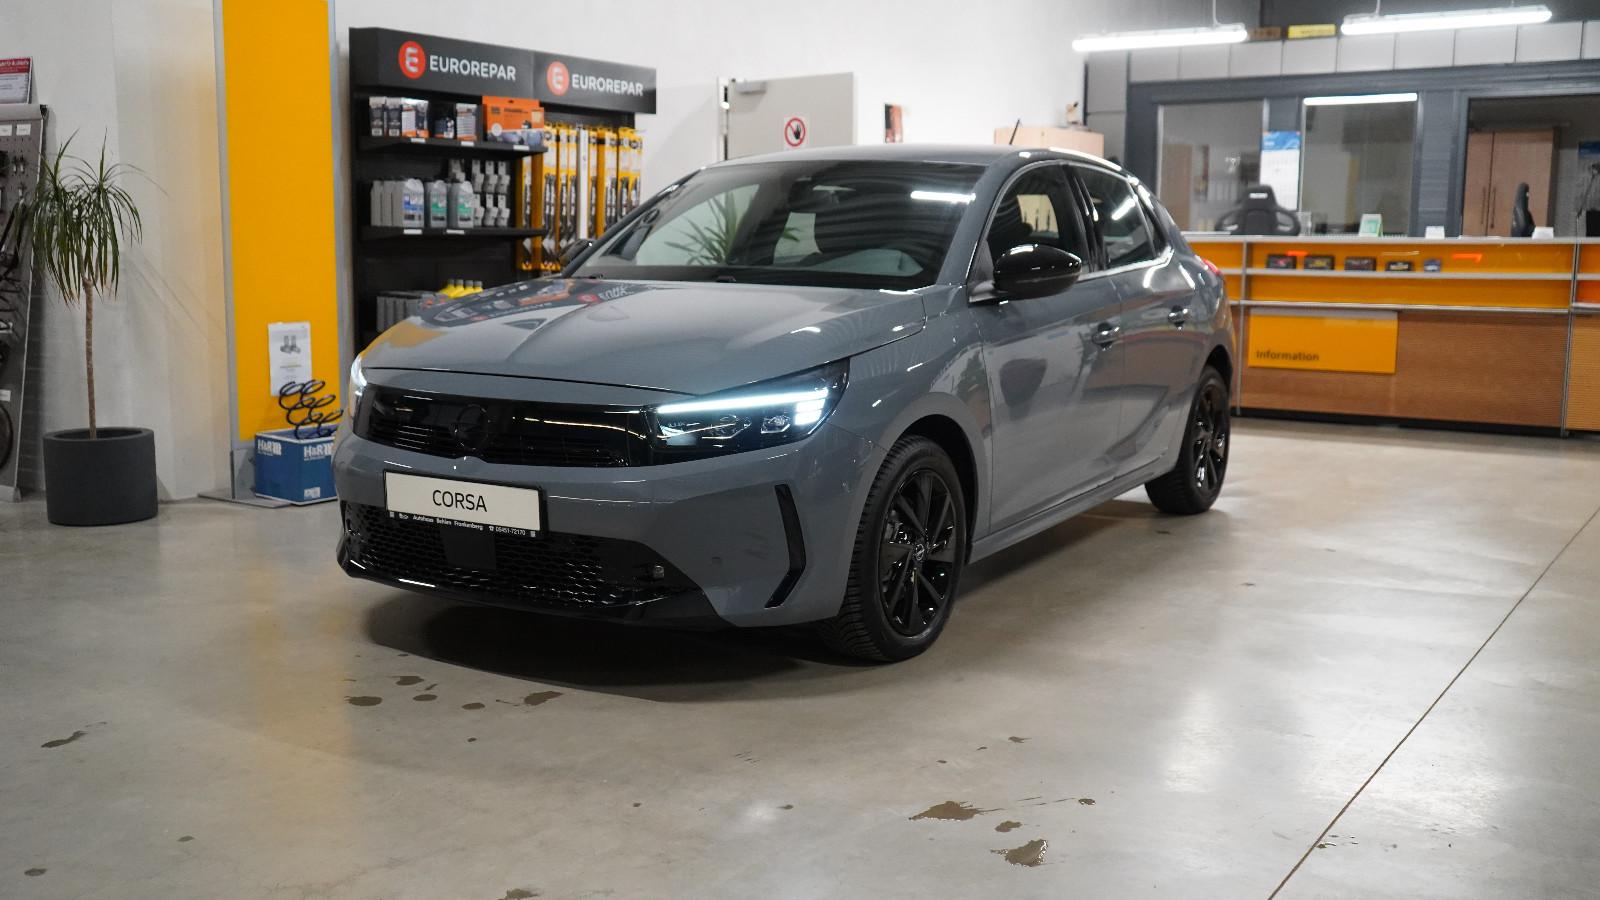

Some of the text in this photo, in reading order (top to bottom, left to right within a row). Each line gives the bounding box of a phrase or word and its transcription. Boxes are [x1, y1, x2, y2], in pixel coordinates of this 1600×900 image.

[429, 54, 516, 81] EUROREPAR
[571, 73, 644, 97] EUROREPAR
[1255, 349, 1320, 363] Information
[432, 489, 488, 513] CORSA
[412, 515, 434, 523] Autohaus
